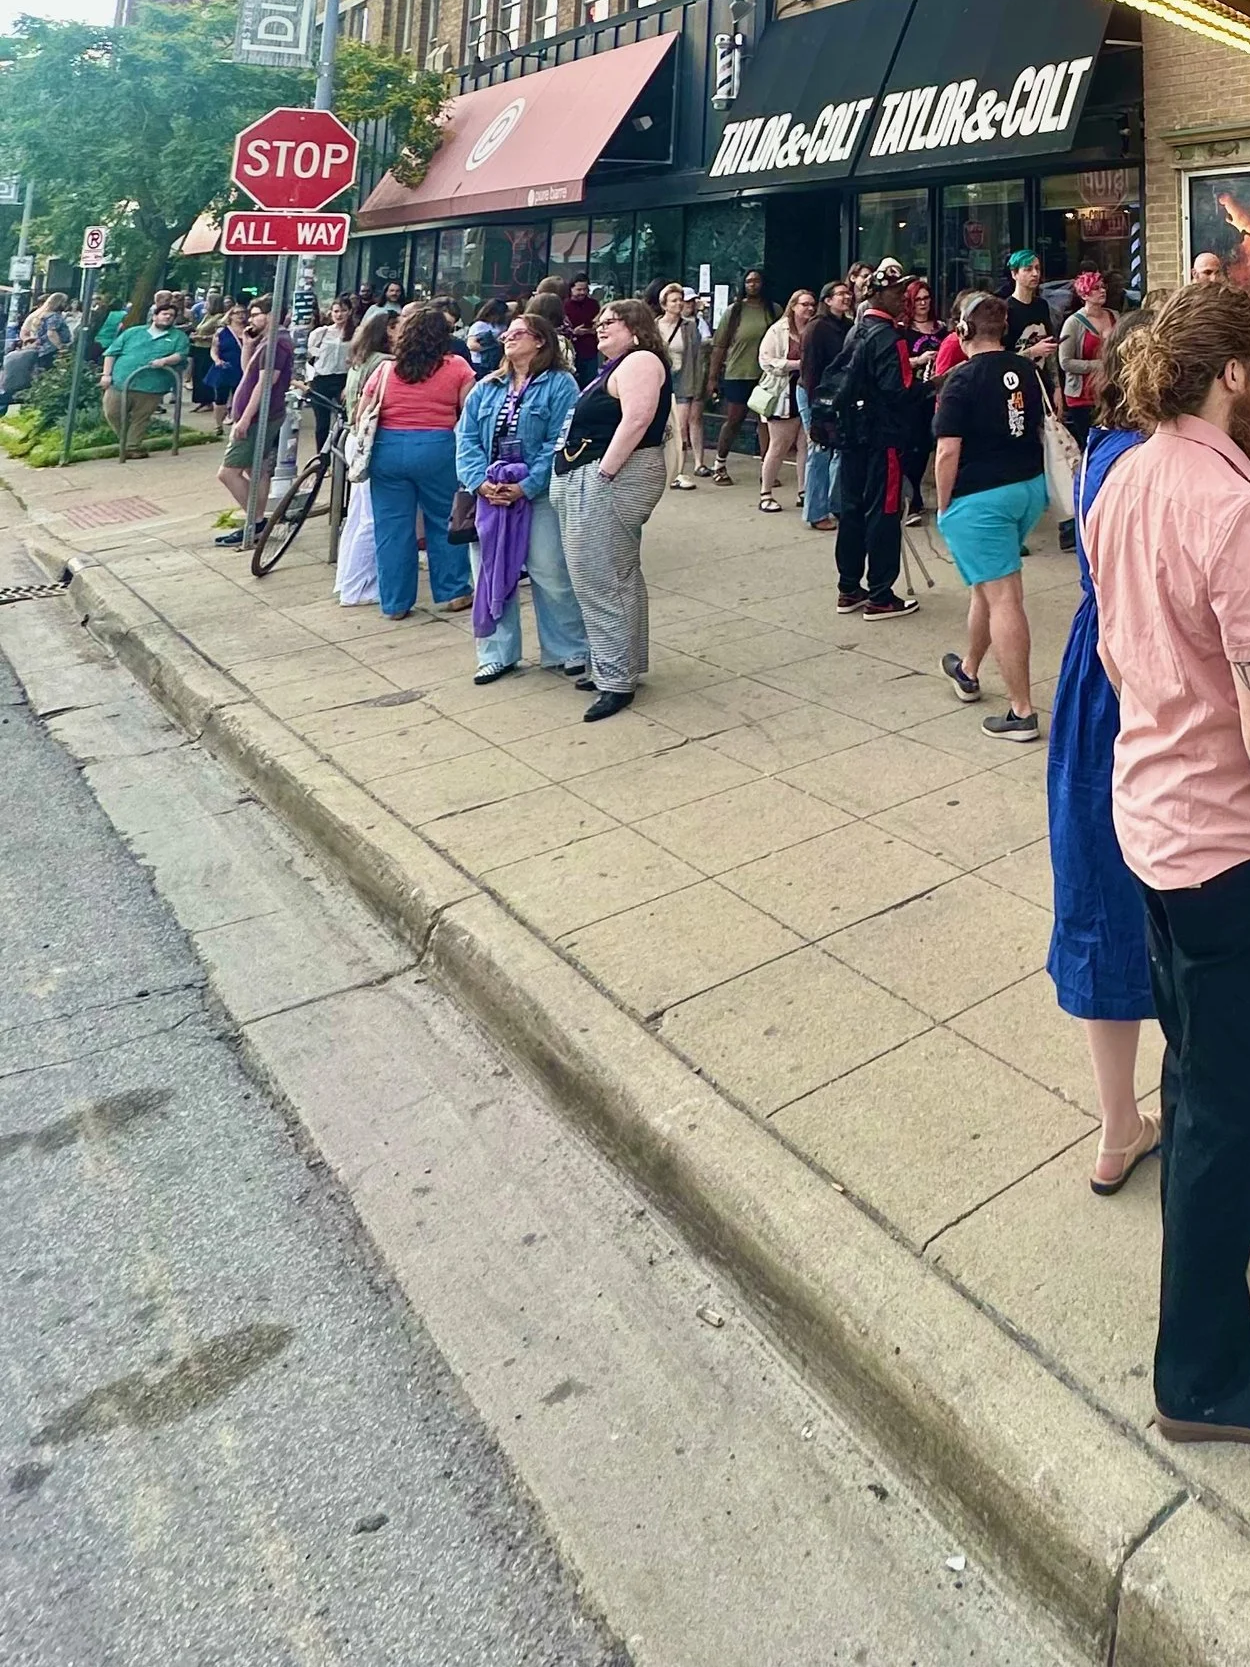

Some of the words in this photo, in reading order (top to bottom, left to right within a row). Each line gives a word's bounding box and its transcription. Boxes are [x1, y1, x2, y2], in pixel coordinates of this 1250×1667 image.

[243, 139, 350, 179] STOP
[229, 221, 277, 245] ALL
[296, 222, 344, 246] WAY
